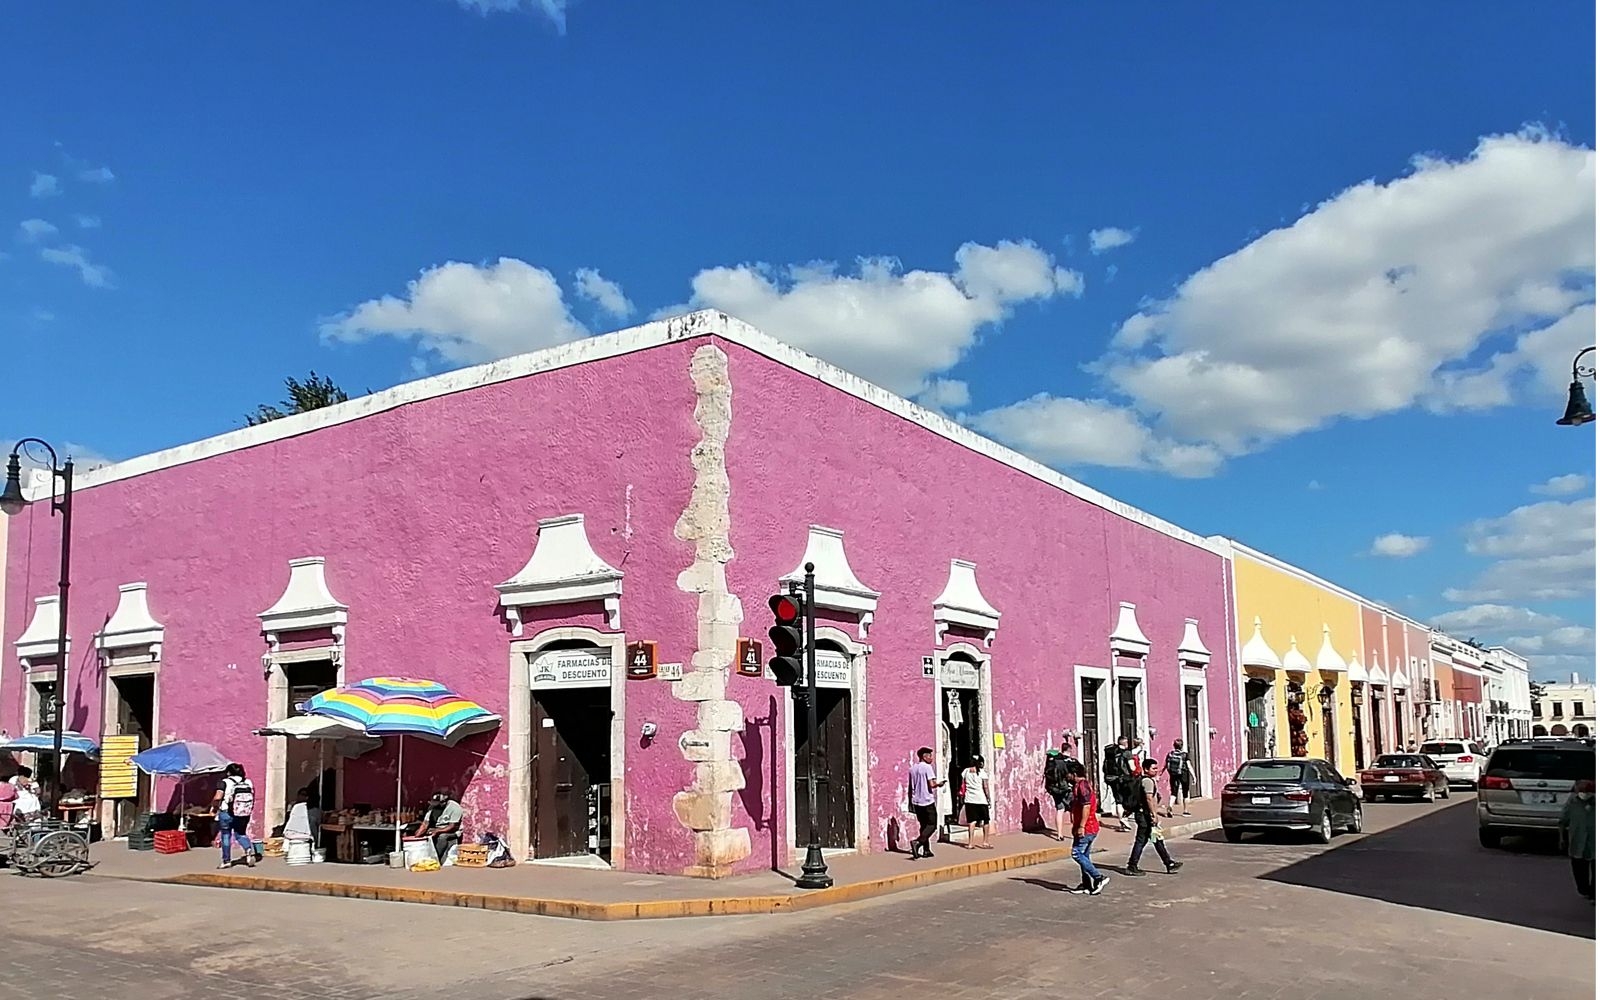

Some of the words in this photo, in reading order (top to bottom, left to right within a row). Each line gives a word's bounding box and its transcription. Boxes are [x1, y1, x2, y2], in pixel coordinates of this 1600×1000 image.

[557, 658, 600, 668] FARMACIAS
[633, 655, 647, 666] 44
[746, 652, 757, 664] 41
[562, 669, 607, 679] DESCUENTO
[816, 670, 847, 680] ESCUENTO
